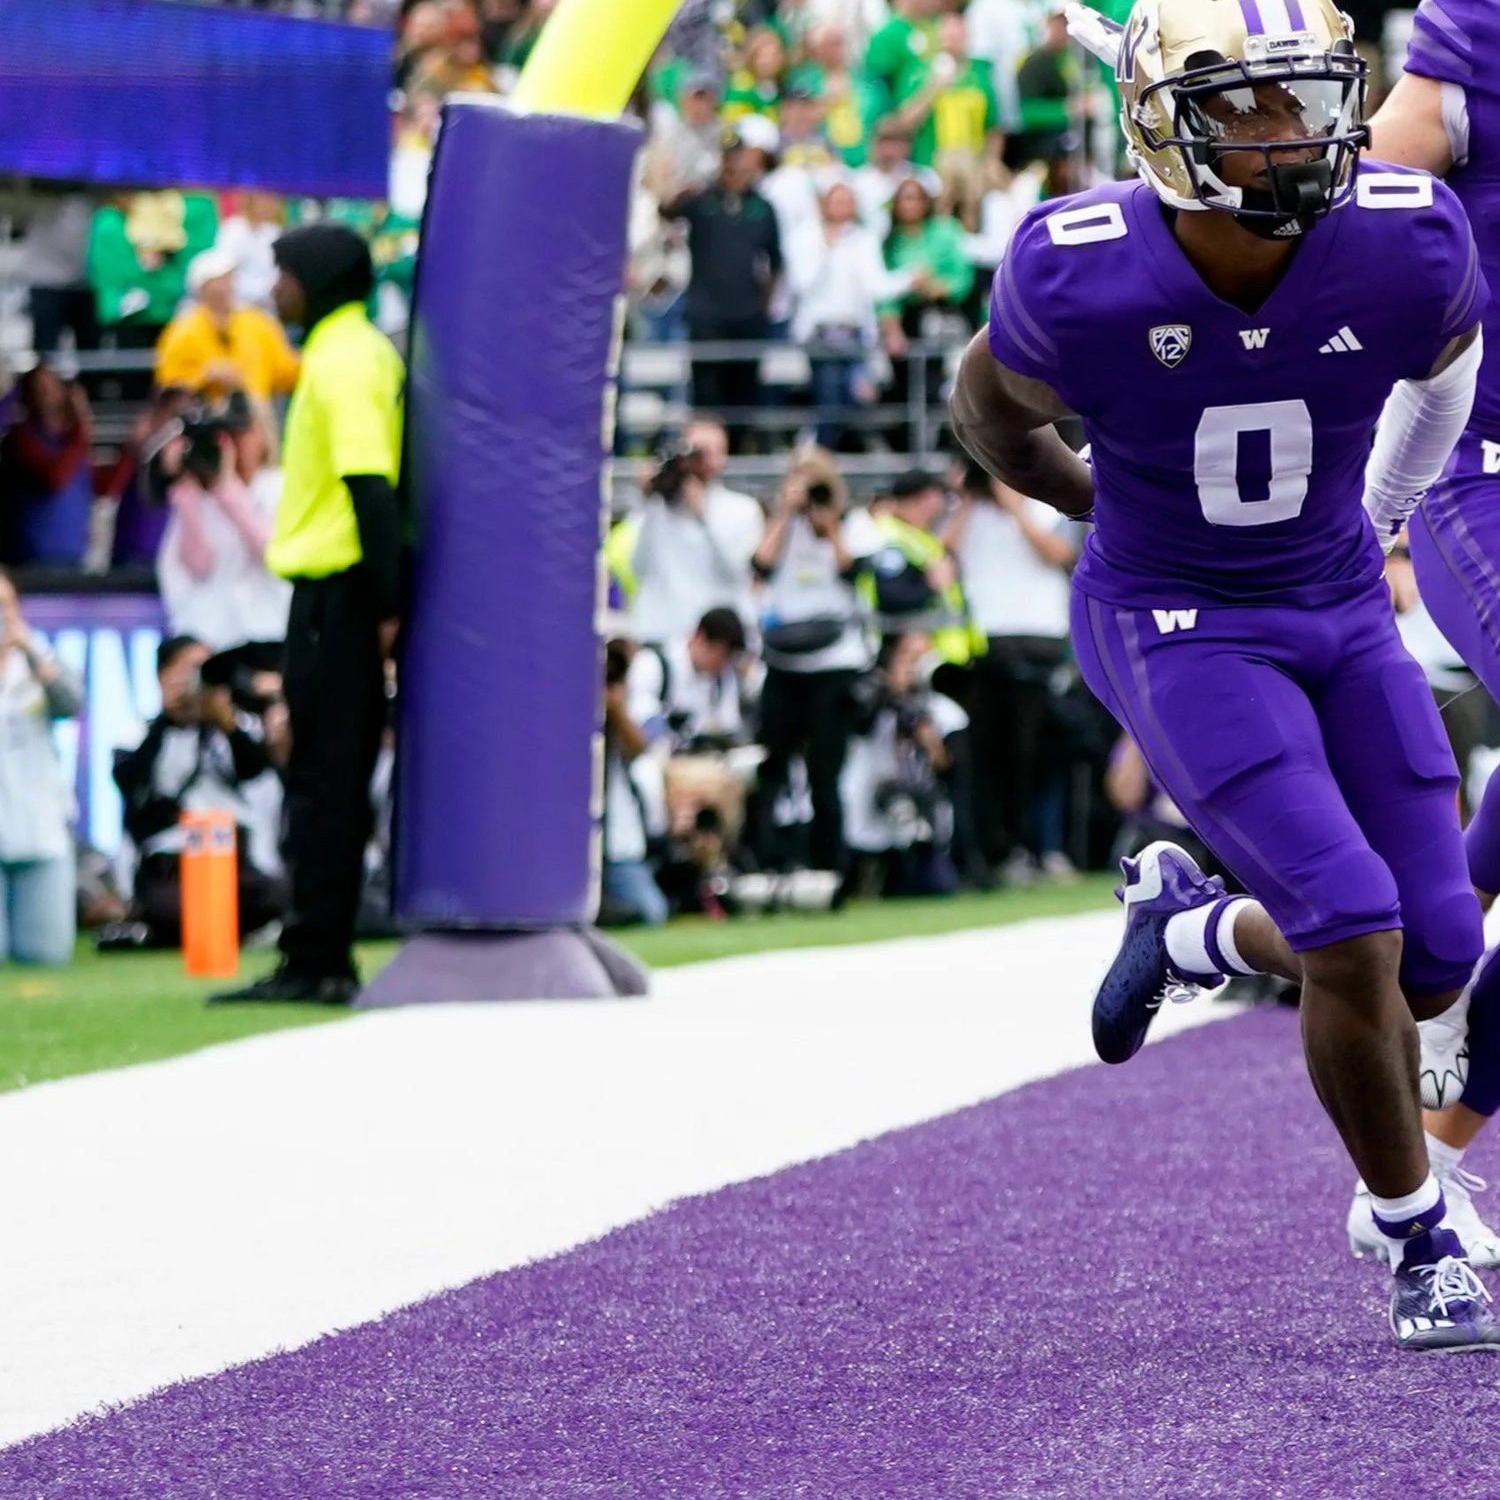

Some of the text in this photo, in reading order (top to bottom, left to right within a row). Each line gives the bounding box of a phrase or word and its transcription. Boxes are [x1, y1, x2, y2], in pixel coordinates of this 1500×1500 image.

[1356, 172, 1433, 209] 0
[1046, 202, 1128, 246] 0
[1152, 327, 1190, 353] PAC
[1160, 343, 1182, 361] 12
[1238, 327, 1271, 351] W
[1194, 398, 1313, 527] 0
[1151, 608, 1198, 635] W
